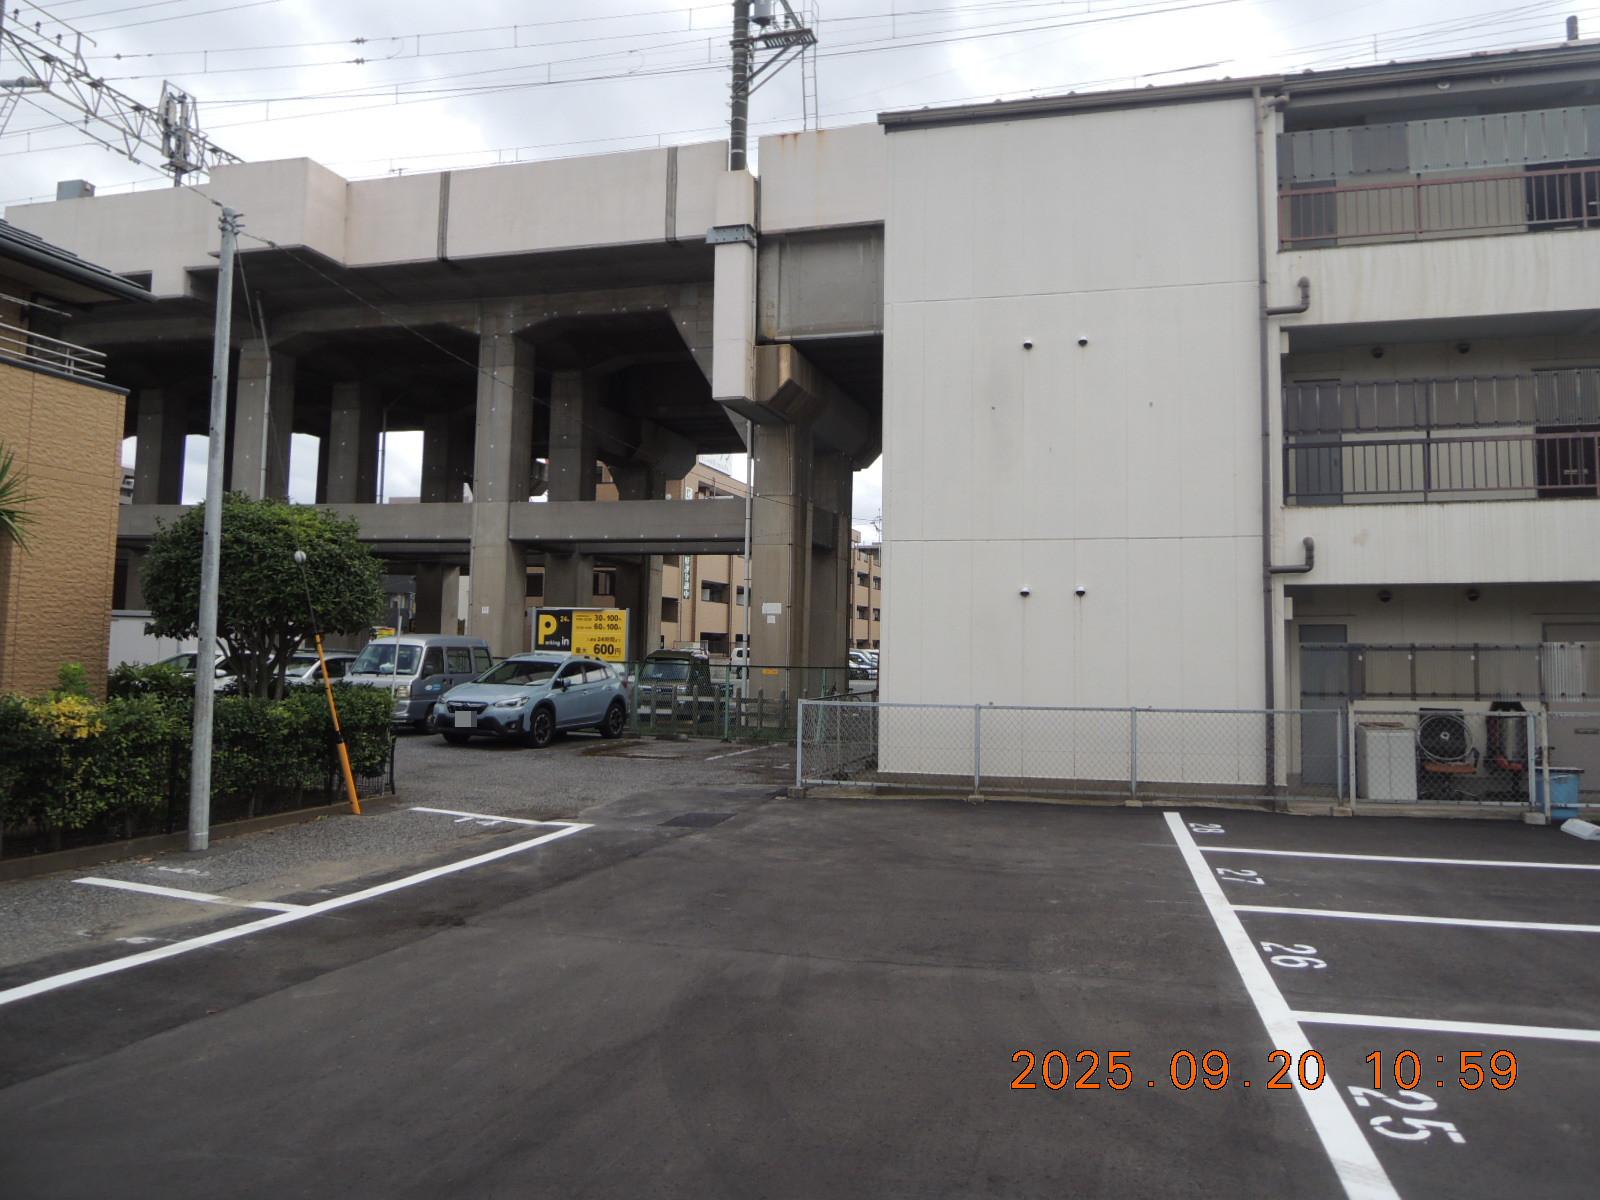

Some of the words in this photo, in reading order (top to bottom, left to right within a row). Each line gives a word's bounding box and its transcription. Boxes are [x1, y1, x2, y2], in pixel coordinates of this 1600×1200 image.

[593, 643, 622, 657] 600円
[1188, 822, 1226, 834] 28
[1260, 941, 1328, 970] 26
[1347, 1085, 1467, 1145] 25
